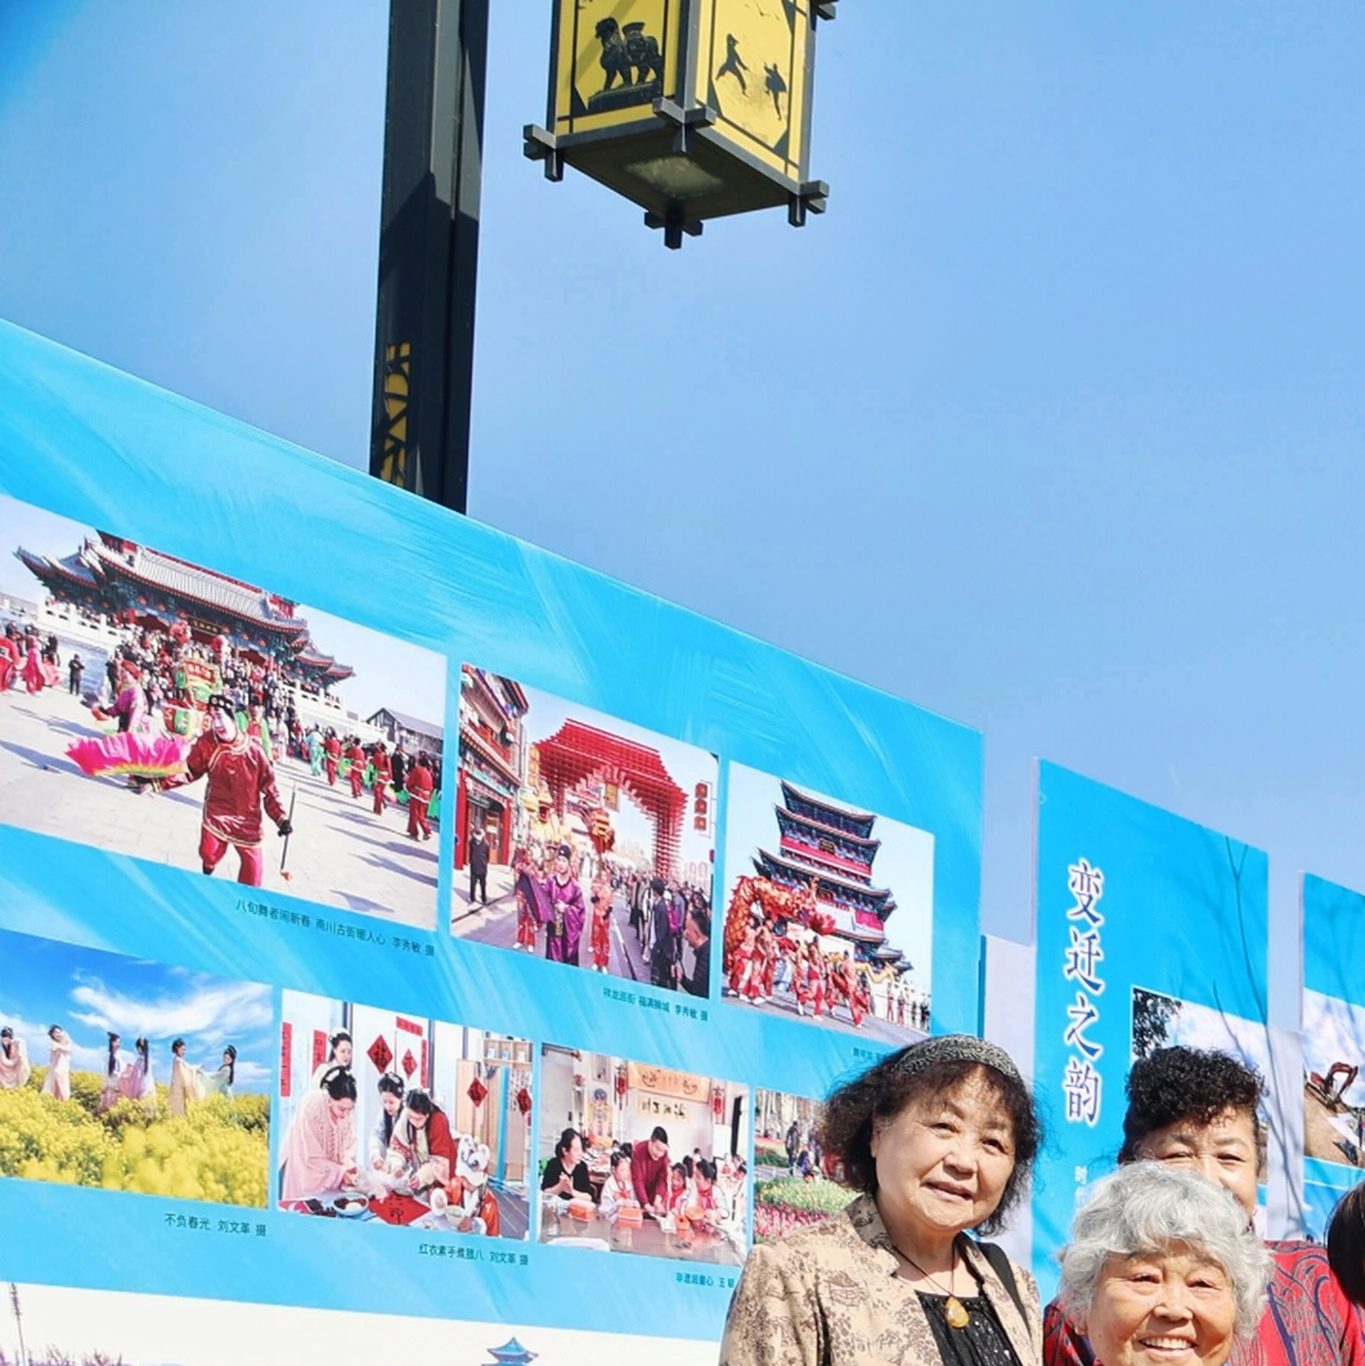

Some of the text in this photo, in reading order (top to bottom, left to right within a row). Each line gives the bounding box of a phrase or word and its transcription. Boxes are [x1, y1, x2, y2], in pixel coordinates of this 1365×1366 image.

[236, 899, 310, 928] 八旬舞者闹新春
[316, 918, 386, 946] 南川古街暖人心
[1065, 861, 1102, 1124] 变迁之韵
[164, 1213, 210, 1230] 不负春光
[218, 1220, 250, 1234] 刘文革
